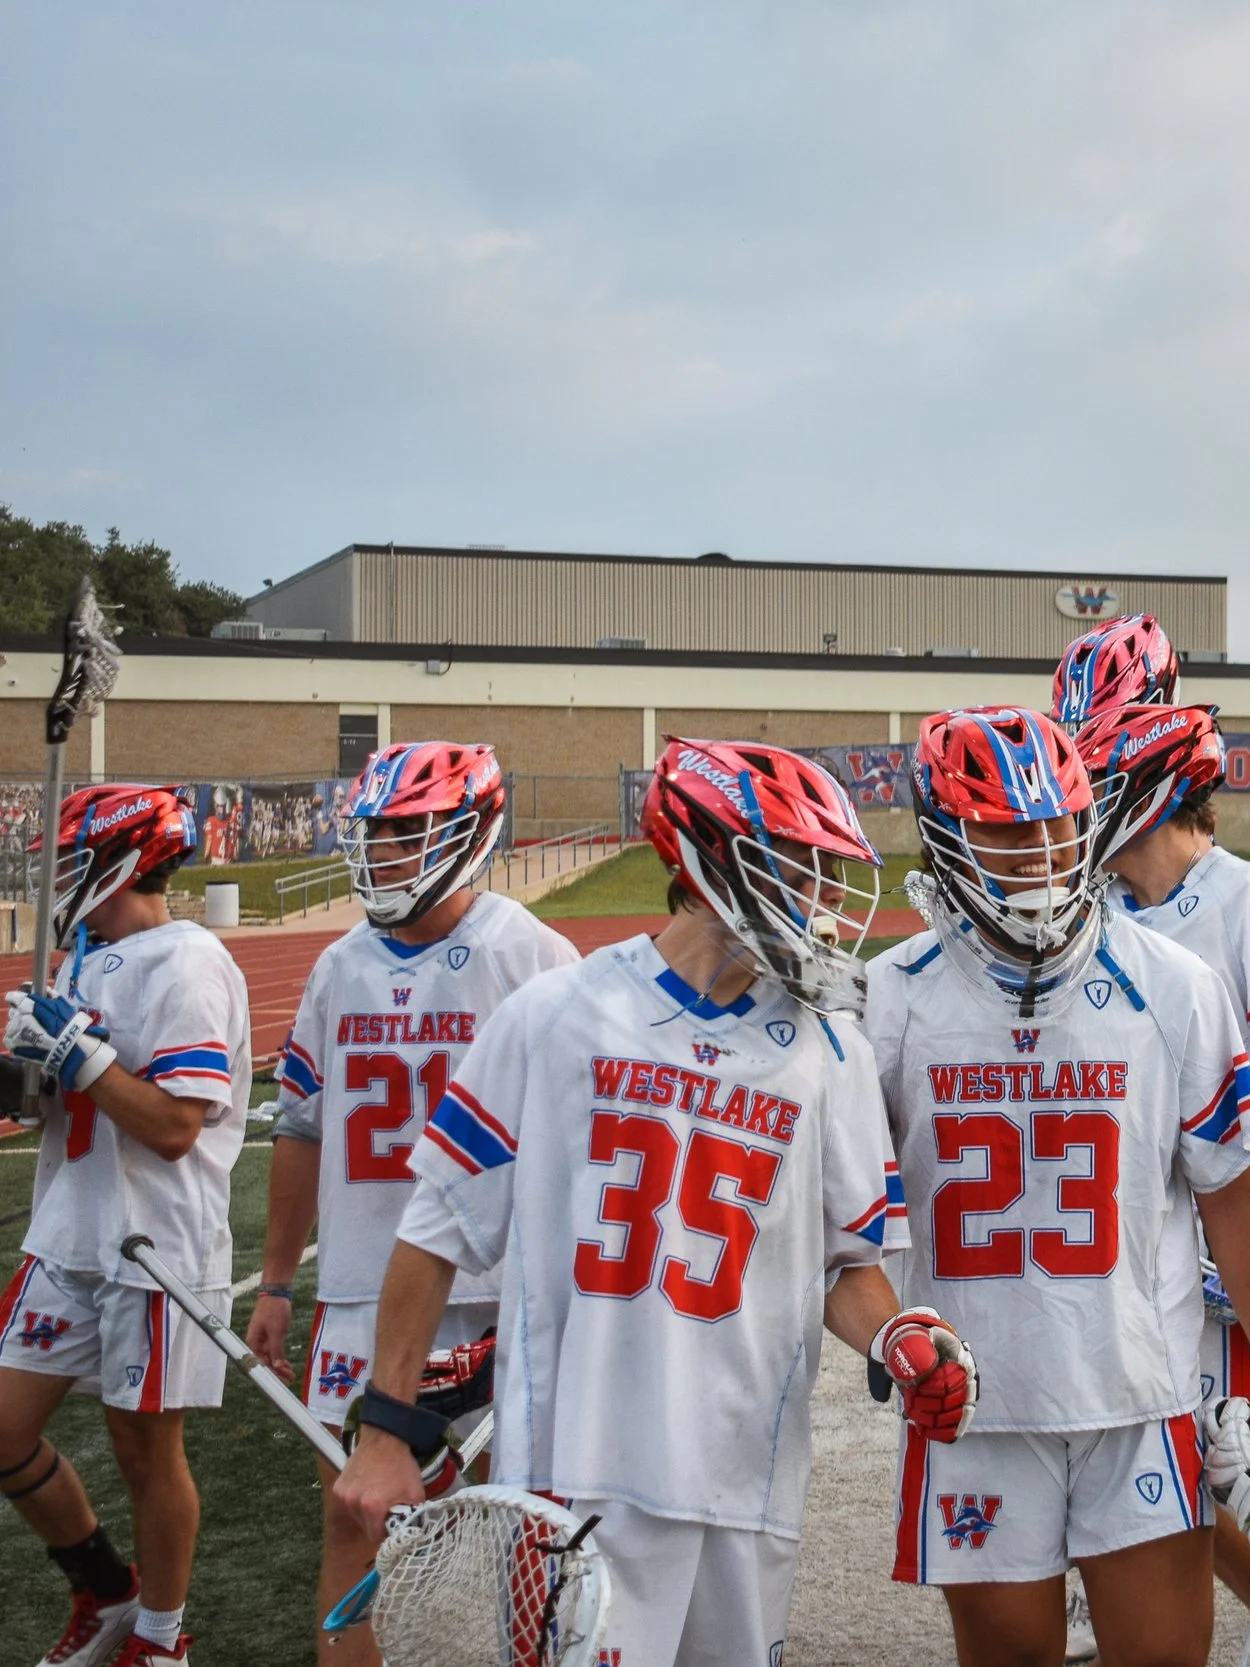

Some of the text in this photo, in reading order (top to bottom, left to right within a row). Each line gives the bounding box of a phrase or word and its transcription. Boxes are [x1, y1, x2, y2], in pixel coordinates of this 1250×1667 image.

[1124, 713, 1188, 759] Westlake
[90, 797, 153, 836] Westlake
[46, 1023, 81, 1075] BRINE
[337, 1012, 476, 1045] WESTLAKE
[592, 1056, 802, 1145] WESTLAKE
[929, 1060, 1128, 1103] WESTLAKE
[573, 1109, 782, 1324] 35
[931, 1111, 1121, 1280] 23
[894, 1346, 917, 1377] TORQUE
